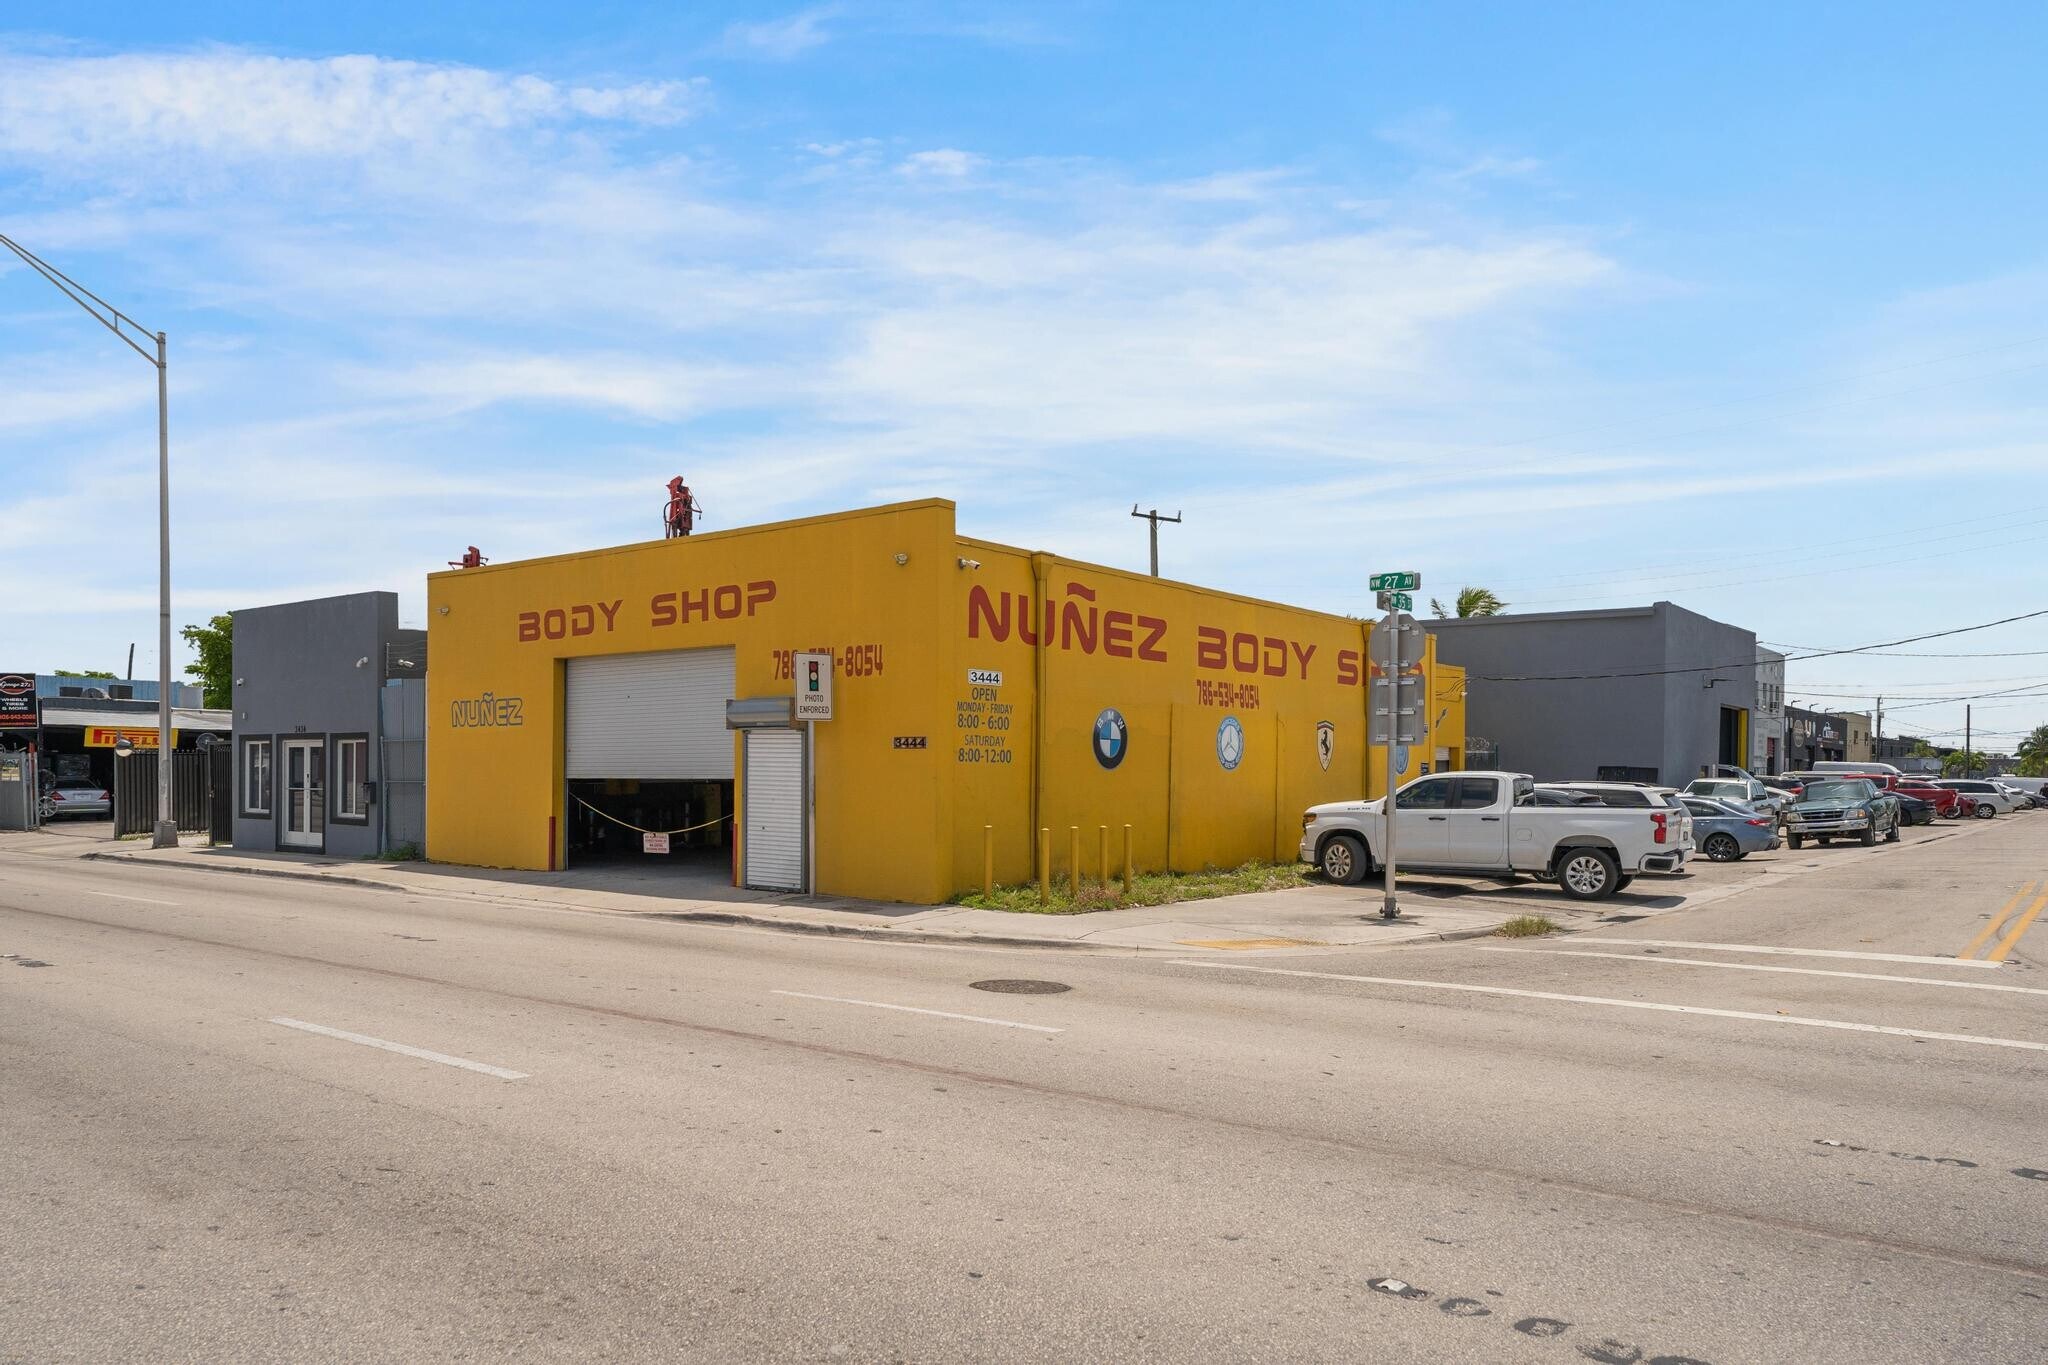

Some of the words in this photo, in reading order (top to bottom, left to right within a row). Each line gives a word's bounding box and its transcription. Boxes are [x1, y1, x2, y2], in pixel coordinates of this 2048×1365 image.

[1370, 578, 1381, 588] NW
[1384, 575, 1398, 589] 27
[1404, 576, 1413, 586] AV
[519, 600, 624, 642] BODY
[650, 580, 777, 627] SHOP
[968, 582, 1168, 663] NUÑEZ
[1198, 625, 1318, 680] BODY
[970, 671, 1000, 684] 3444
[804, 694, 824, 703] PHOTO
[971, 687, 997, 702] OPEN
[1197, 679, 1260, 710] 786-534-8054
[451, 691, 524, 728] NUÑEZ
[800, 705, 830, 714] ENFORCED
[956, 701, 986, 713] MONDAY
[990, 703, 1014, 714] FRIDAY
[957, 714, 979, 729] 8:00
[987, 715, 1010, 730] 6:00
[1096, 711, 1125, 729] BMW
[893, 736, 926, 749] 3444
[964, 734, 1006, 747] SATURDAY
[958, 748, 1012, 763] 8:00-12:00
